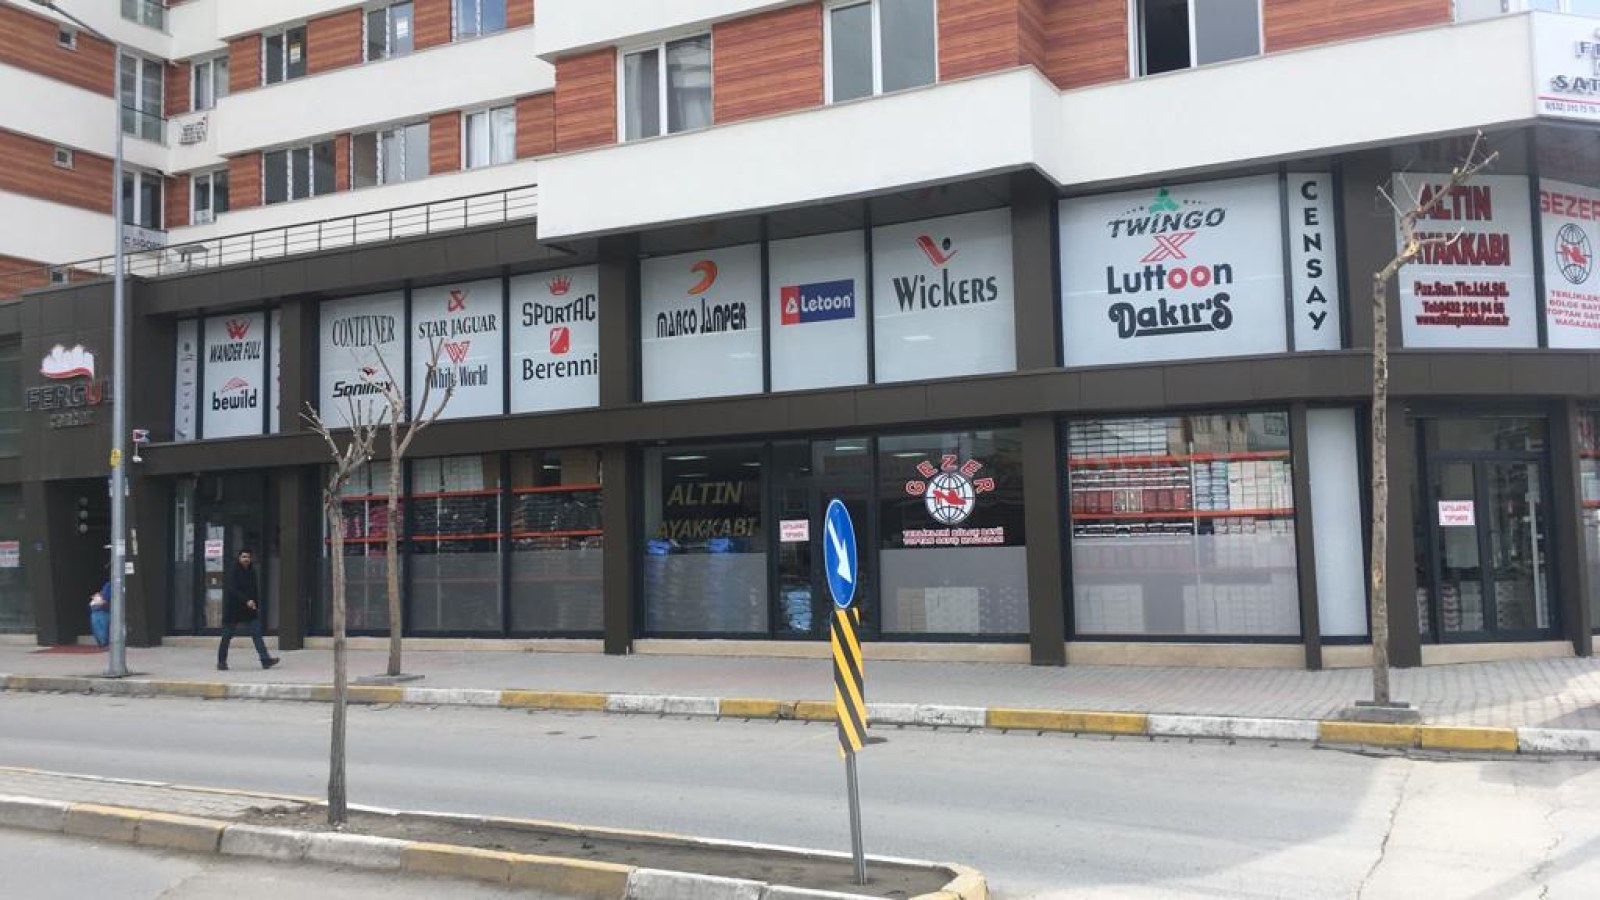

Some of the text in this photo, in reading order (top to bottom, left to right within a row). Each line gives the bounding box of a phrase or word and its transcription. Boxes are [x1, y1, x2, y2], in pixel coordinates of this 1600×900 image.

[1417, 184, 1493, 220] ALTIN
[1301, 182, 1327, 330] CENSAY
[1106, 263, 1233, 294] Luttoon
[801, 293, 851, 312] Letoon
[418, 314, 497, 339] STAR JAGUAR
[657, 308, 698, 338] MARCO
[209, 342, 243, 363] WANDER
[459, 364, 488, 387] World
[522, 352, 598, 381] Berenni
[212, 388, 258, 411] bewild
[906, 454, 995, 496] GEZER
[667, 481, 743, 506] ALTIN
[655, 517, 758, 539] AYAKKABI
